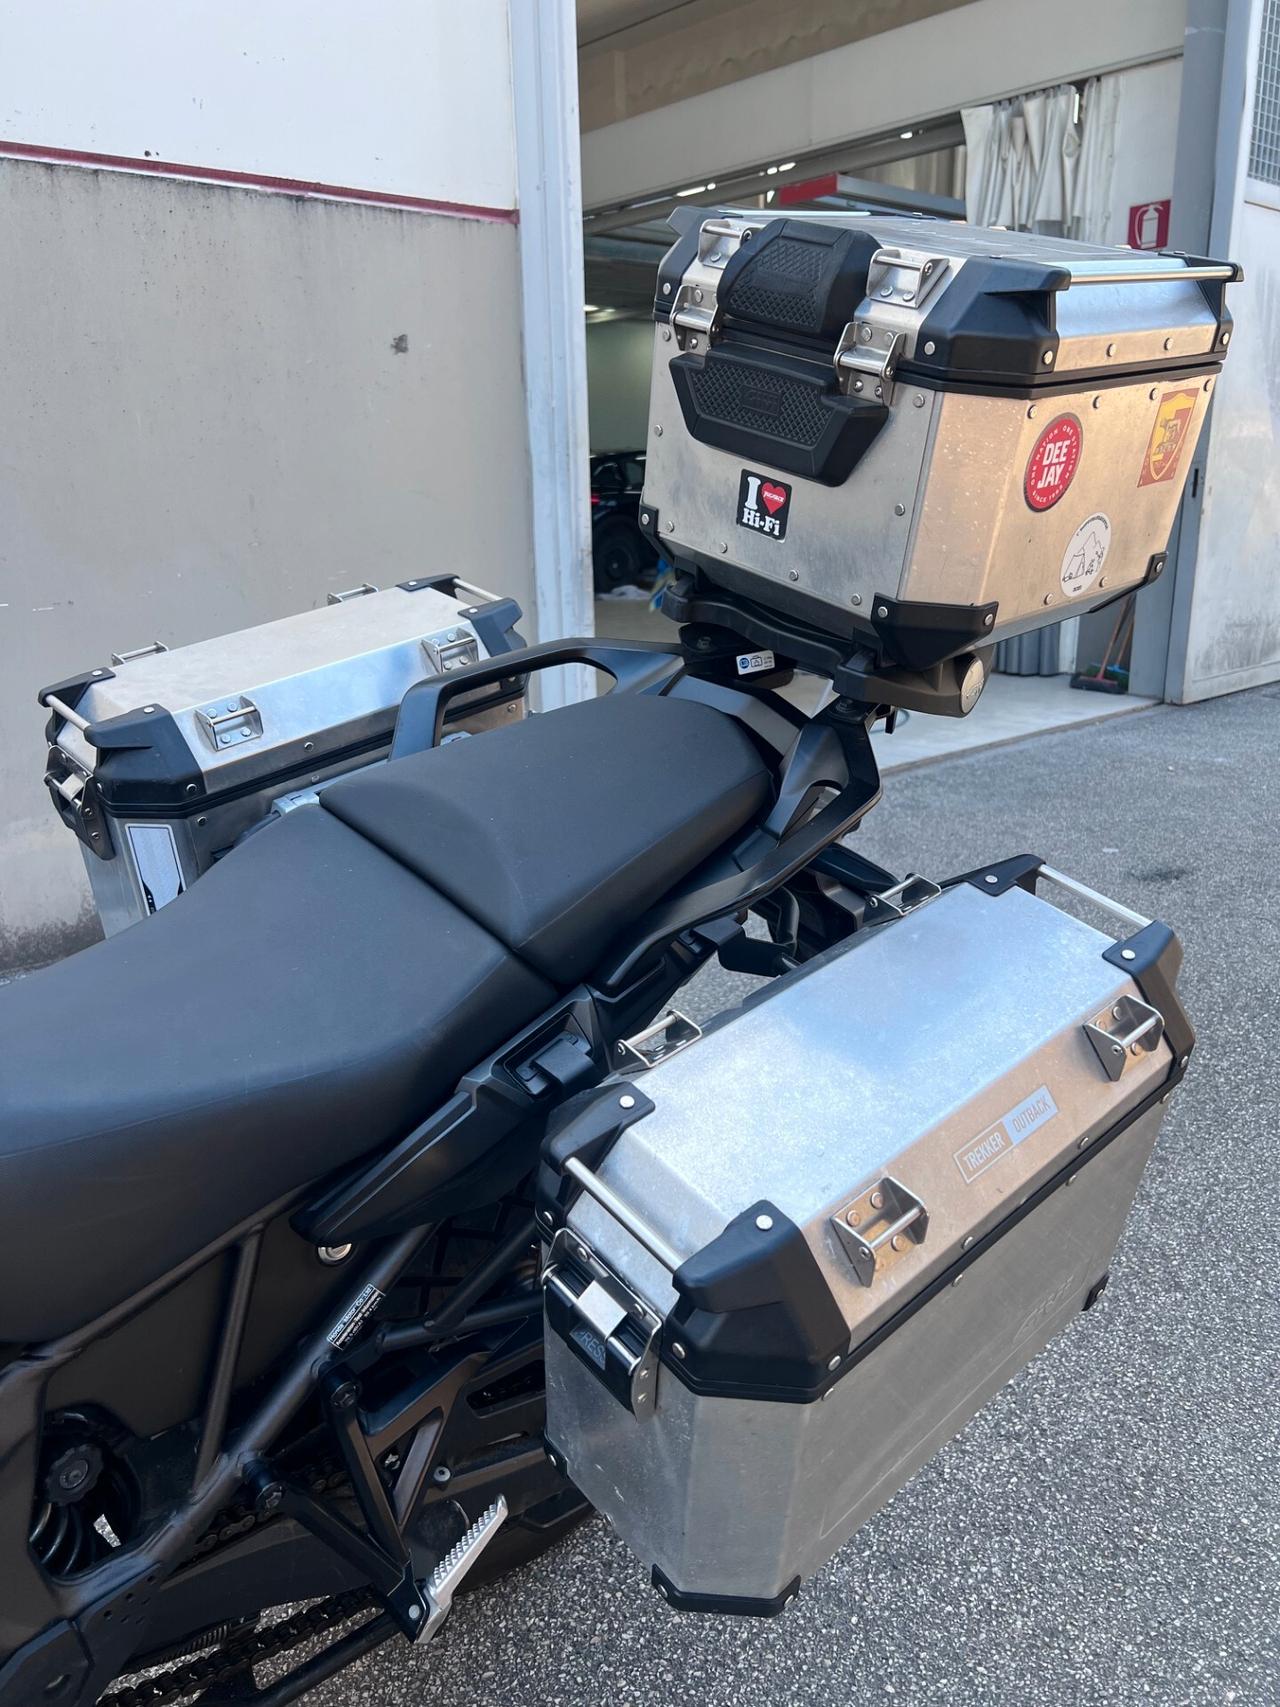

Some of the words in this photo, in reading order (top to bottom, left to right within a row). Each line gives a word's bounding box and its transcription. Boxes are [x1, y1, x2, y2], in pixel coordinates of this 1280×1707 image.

[1042, 440, 1070, 465] DEE
[1036, 463, 1064, 489] JAY
[744, 476, 761, 510] I
[742, 508, 780, 536] Hi-Fi
[964, 1132, 1006, 1171] TREKKER
[1012, 1096, 1051, 1133] OUTBACK
[328, 1323, 345, 1341] Honda
[343, 1306, 357, 1323] Motor
